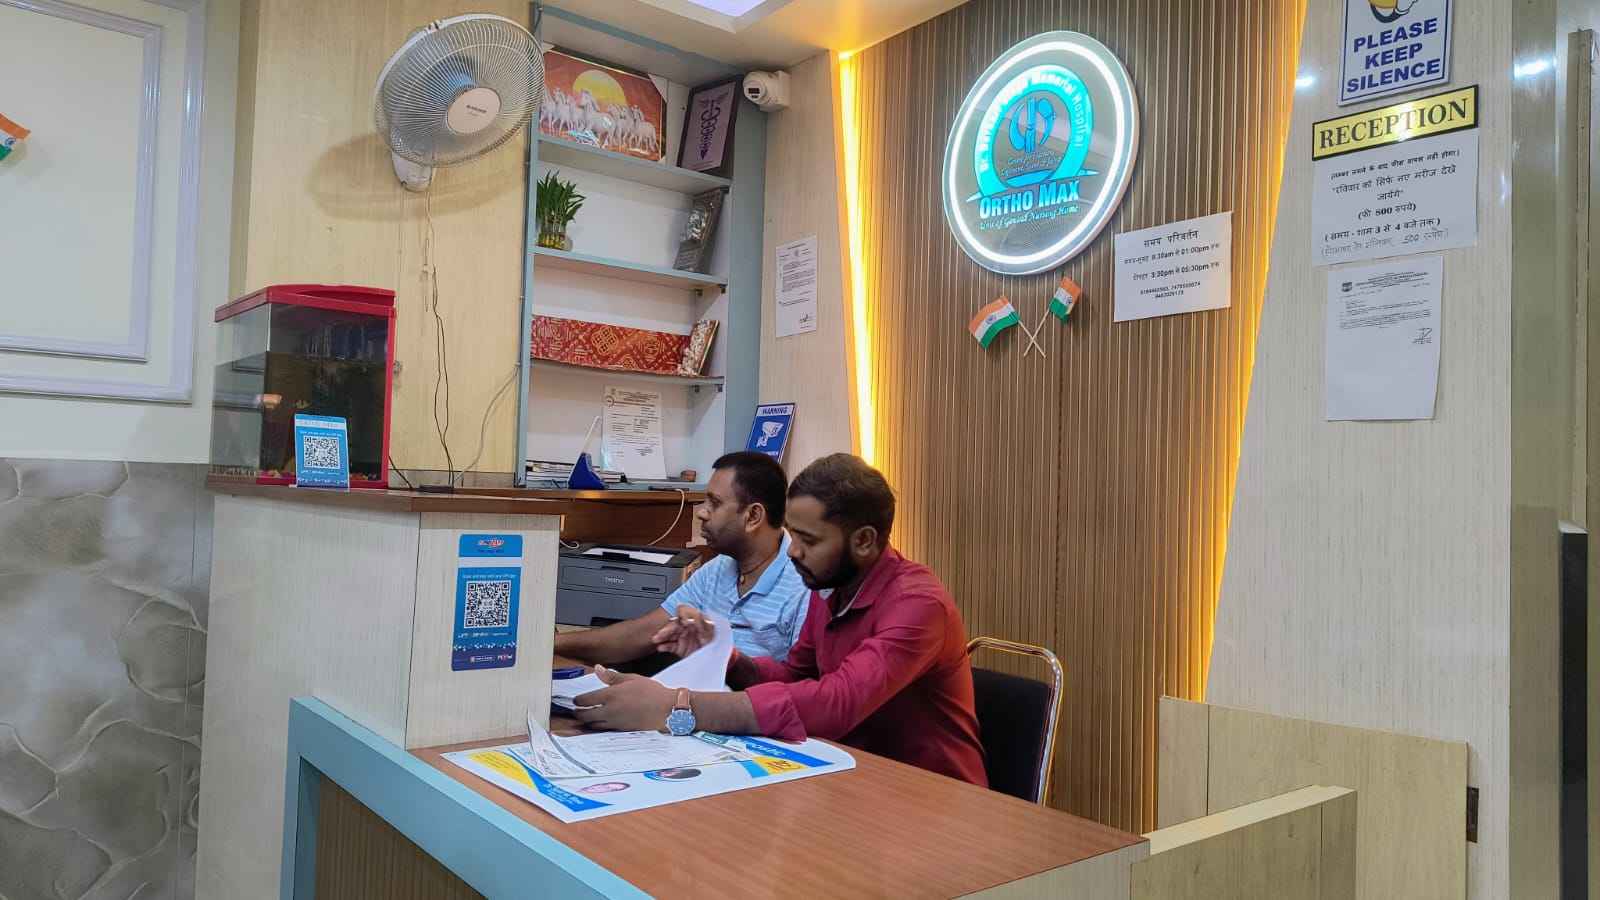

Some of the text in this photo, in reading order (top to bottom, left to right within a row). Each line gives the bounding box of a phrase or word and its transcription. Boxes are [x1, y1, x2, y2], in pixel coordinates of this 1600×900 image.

[1354, 18, 1438, 52] PLEASE
[1365, 43, 1423, 69] KEEP
[1347, 58, 1441, 93] SILENCE
[1320, 98, 1468, 149] RECEPTION
[1362, 180, 1372, 189] को
[1414, 168, 1437, 179] मरीज
[980, 190, 1033, 219] ORTHO
[1375, 207, 1393, 217] 500
[1144, 229, 1199, 248] समय परिवर्तन
[1331, 230, 1349, 240] समय
[1383, 223, 1391, 232] से
[1404, 219, 1417, 229] बजे
[762, 407, 788, 415] WARNING
